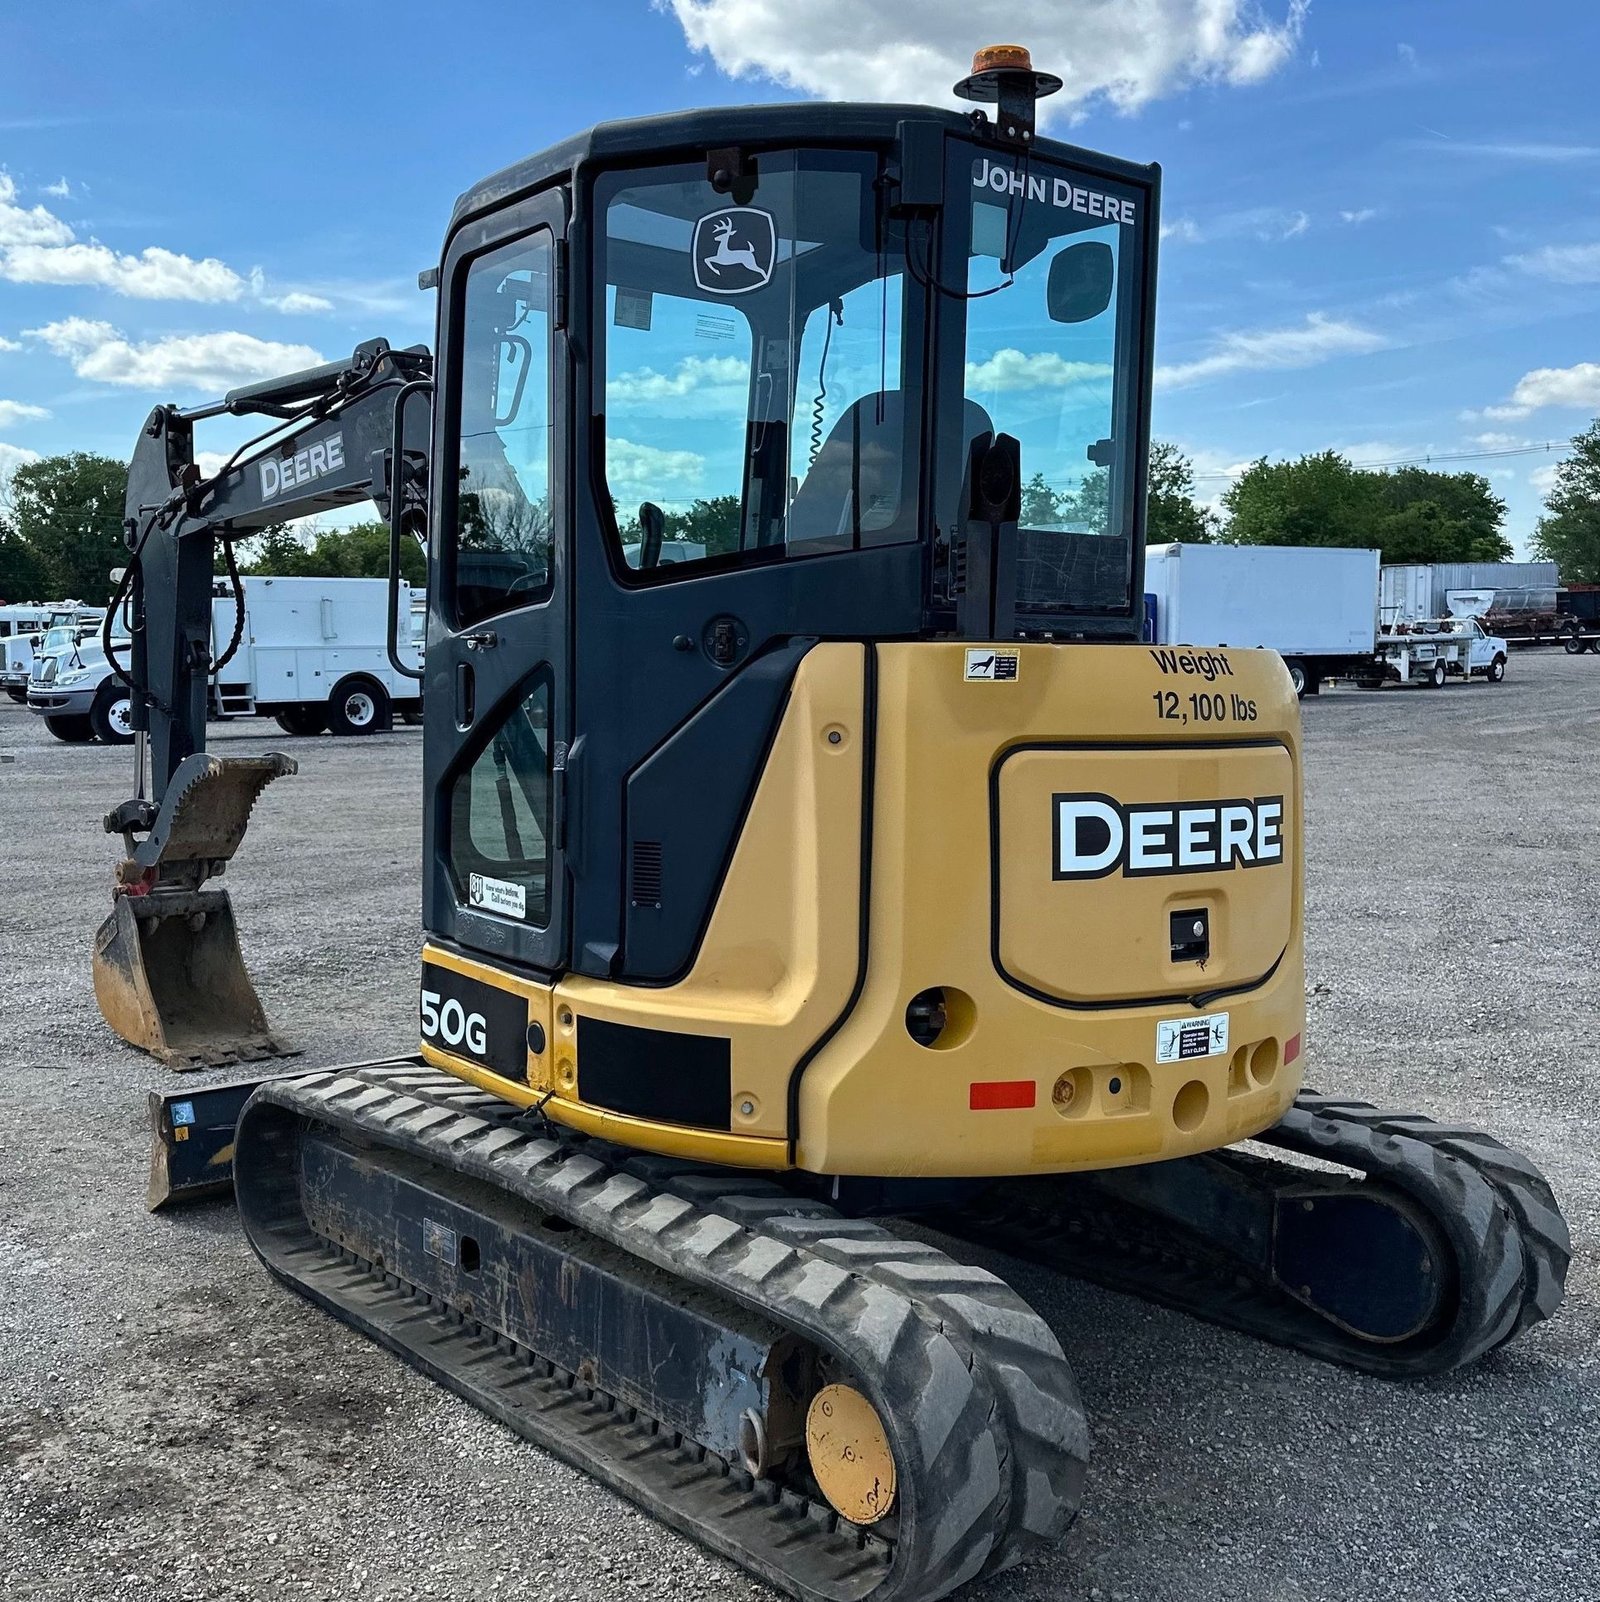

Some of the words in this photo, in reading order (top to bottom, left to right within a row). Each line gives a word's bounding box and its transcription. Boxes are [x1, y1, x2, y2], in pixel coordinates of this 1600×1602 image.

[973, 158, 1046, 203] JOHN
[1052, 178, 1136, 226] DEERE
[261, 435, 344, 498] DEERE
[1150, 649, 1235, 681] Weight
[1153, 690, 1226, 725] 12,100
[1232, 693, 1258, 722] lbs
[1059, 800, 1281, 873] DEERE
[422, 989, 487, 1055] 50G
